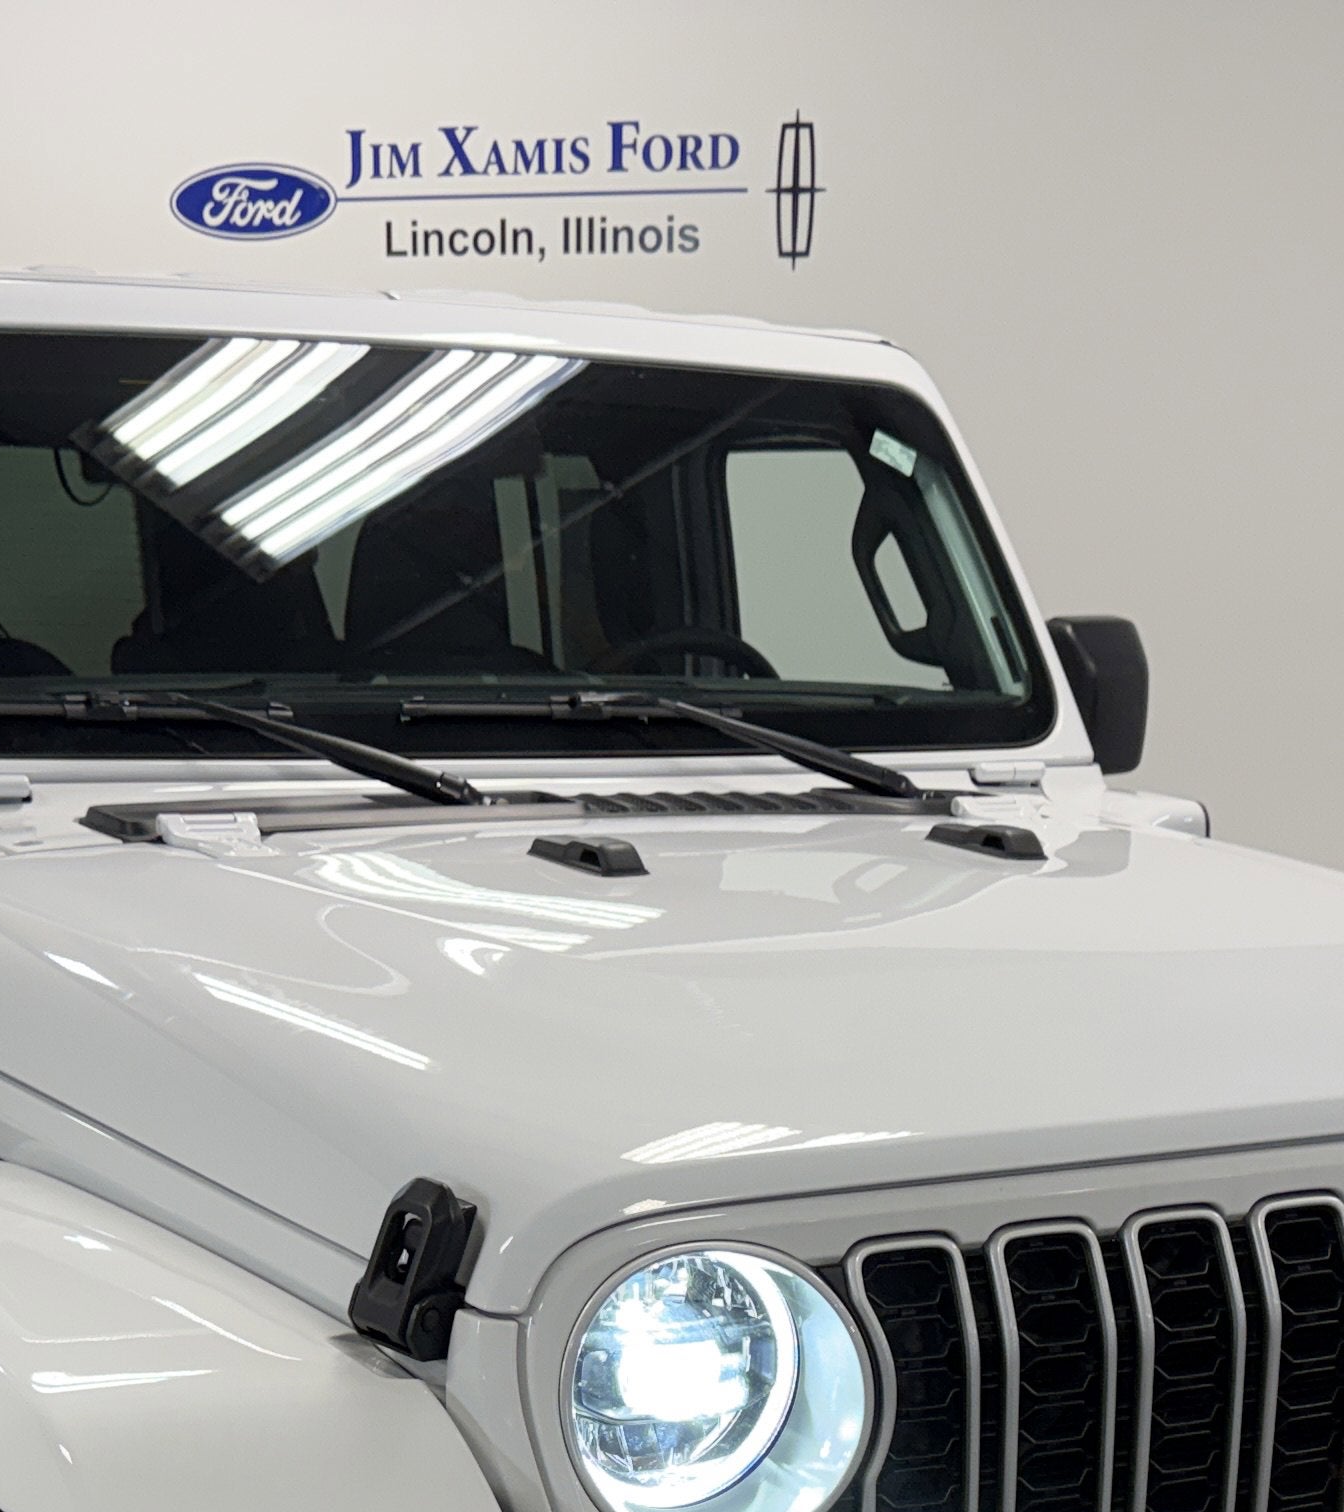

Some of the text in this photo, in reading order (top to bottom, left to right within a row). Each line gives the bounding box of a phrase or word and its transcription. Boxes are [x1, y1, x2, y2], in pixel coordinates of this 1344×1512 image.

[345, 120, 740, 188] JIM XAMIS FORD
[202, 176, 306, 230] Ford
[385, 215, 700, 261] Lincoln, Illinois
